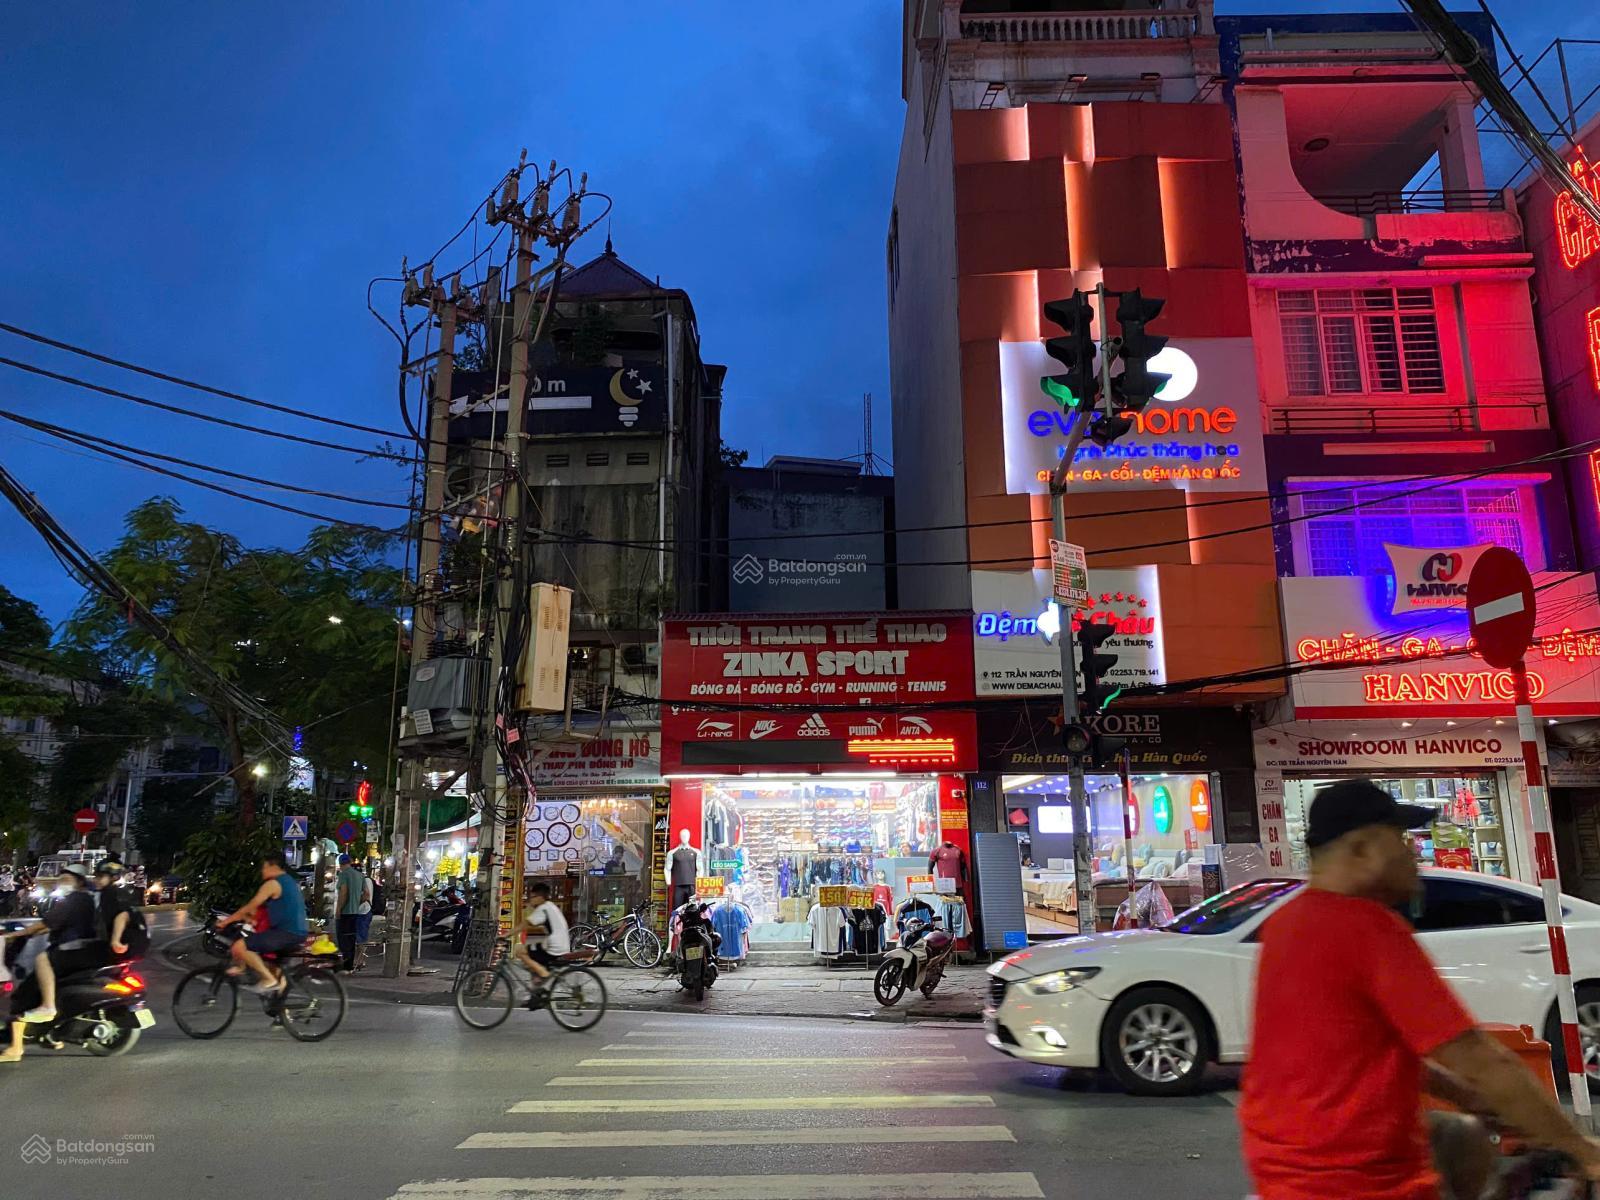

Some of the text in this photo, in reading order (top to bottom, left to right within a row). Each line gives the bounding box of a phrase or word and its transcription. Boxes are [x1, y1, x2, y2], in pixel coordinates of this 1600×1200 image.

[1082, 469, 1102, 481] GA
[1110, 461, 1134, 481] GỐI
[1143, 464, 1171, 483] ĐỆM
[687, 622, 742, 646] THỜI
[747, 625, 827, 645] TRANG
[884, 623, 947, 643] THAO
[978, 611, 1037, 641] Đệm
[1105, 637, 1154, 649] yêu thương
[1298, 632, 1381, 662] CHĂN
[723, 650, 909, 677] ZINKA SPORT
[1005, 667, 1028, 678] TRẦN
[1109, 669, 1159, 677] 02253.719.141
[690, 677, 947, 695] BÓNG ĐÁ BÓNG RỔ GYM RUNNING TENNIS
[1363, 671, 1545, 701] HANVICO
[754, 720, 777, 731] NIKE
[797, 728, 831, 737] adidas
[848, 725, 877, 736] PUMA
[900, 725, 921, 736] ANTA
[1297, 738, 1502, 756] SHOWROOM HANVICO
[1011, 752, 1043, 764] Đích
[1142, 752, 1170, 763] Hàn
[1172, 750, 1208, 765] Quốc
[976, 781, 988, 789] 112
[1262, 800, 1282, 820] CHĂN
[1269, 826, 1280, 843] GA
[1269, 847, 1284, 867] GỐI
[696, 877, 723, 888] 150K
